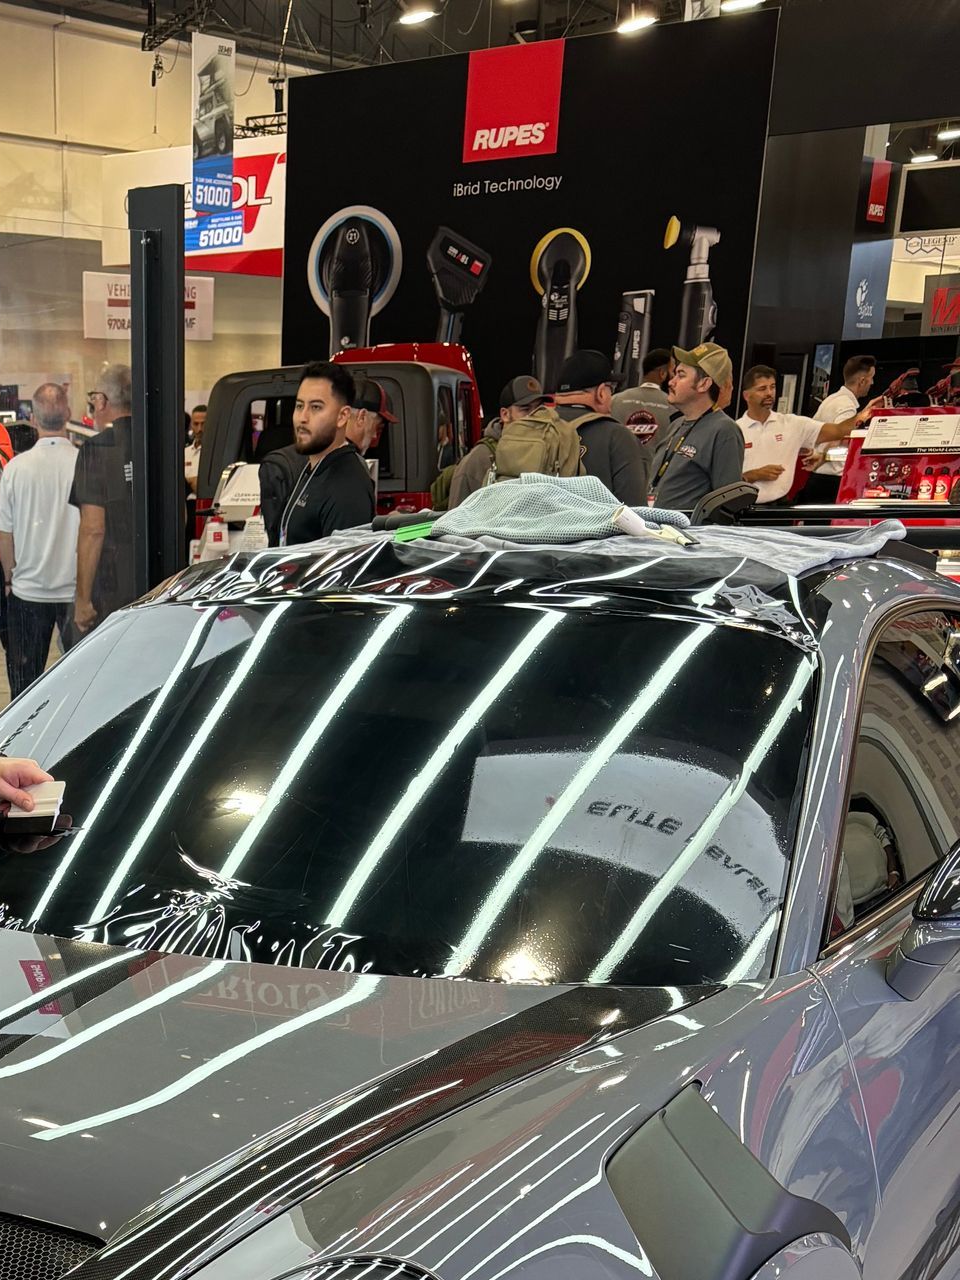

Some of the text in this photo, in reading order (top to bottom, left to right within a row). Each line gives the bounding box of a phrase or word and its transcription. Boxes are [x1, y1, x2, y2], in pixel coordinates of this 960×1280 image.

[472, 122, 546, 151] RUPES
[195, 184, 230, 207] 51000
[453, 175, 562, 197] iBrid Technology
[199, 226, 243, 247] 51000
[107, 283, 131, 298] VEHI
[632, 330, 640, 359] RUPES
